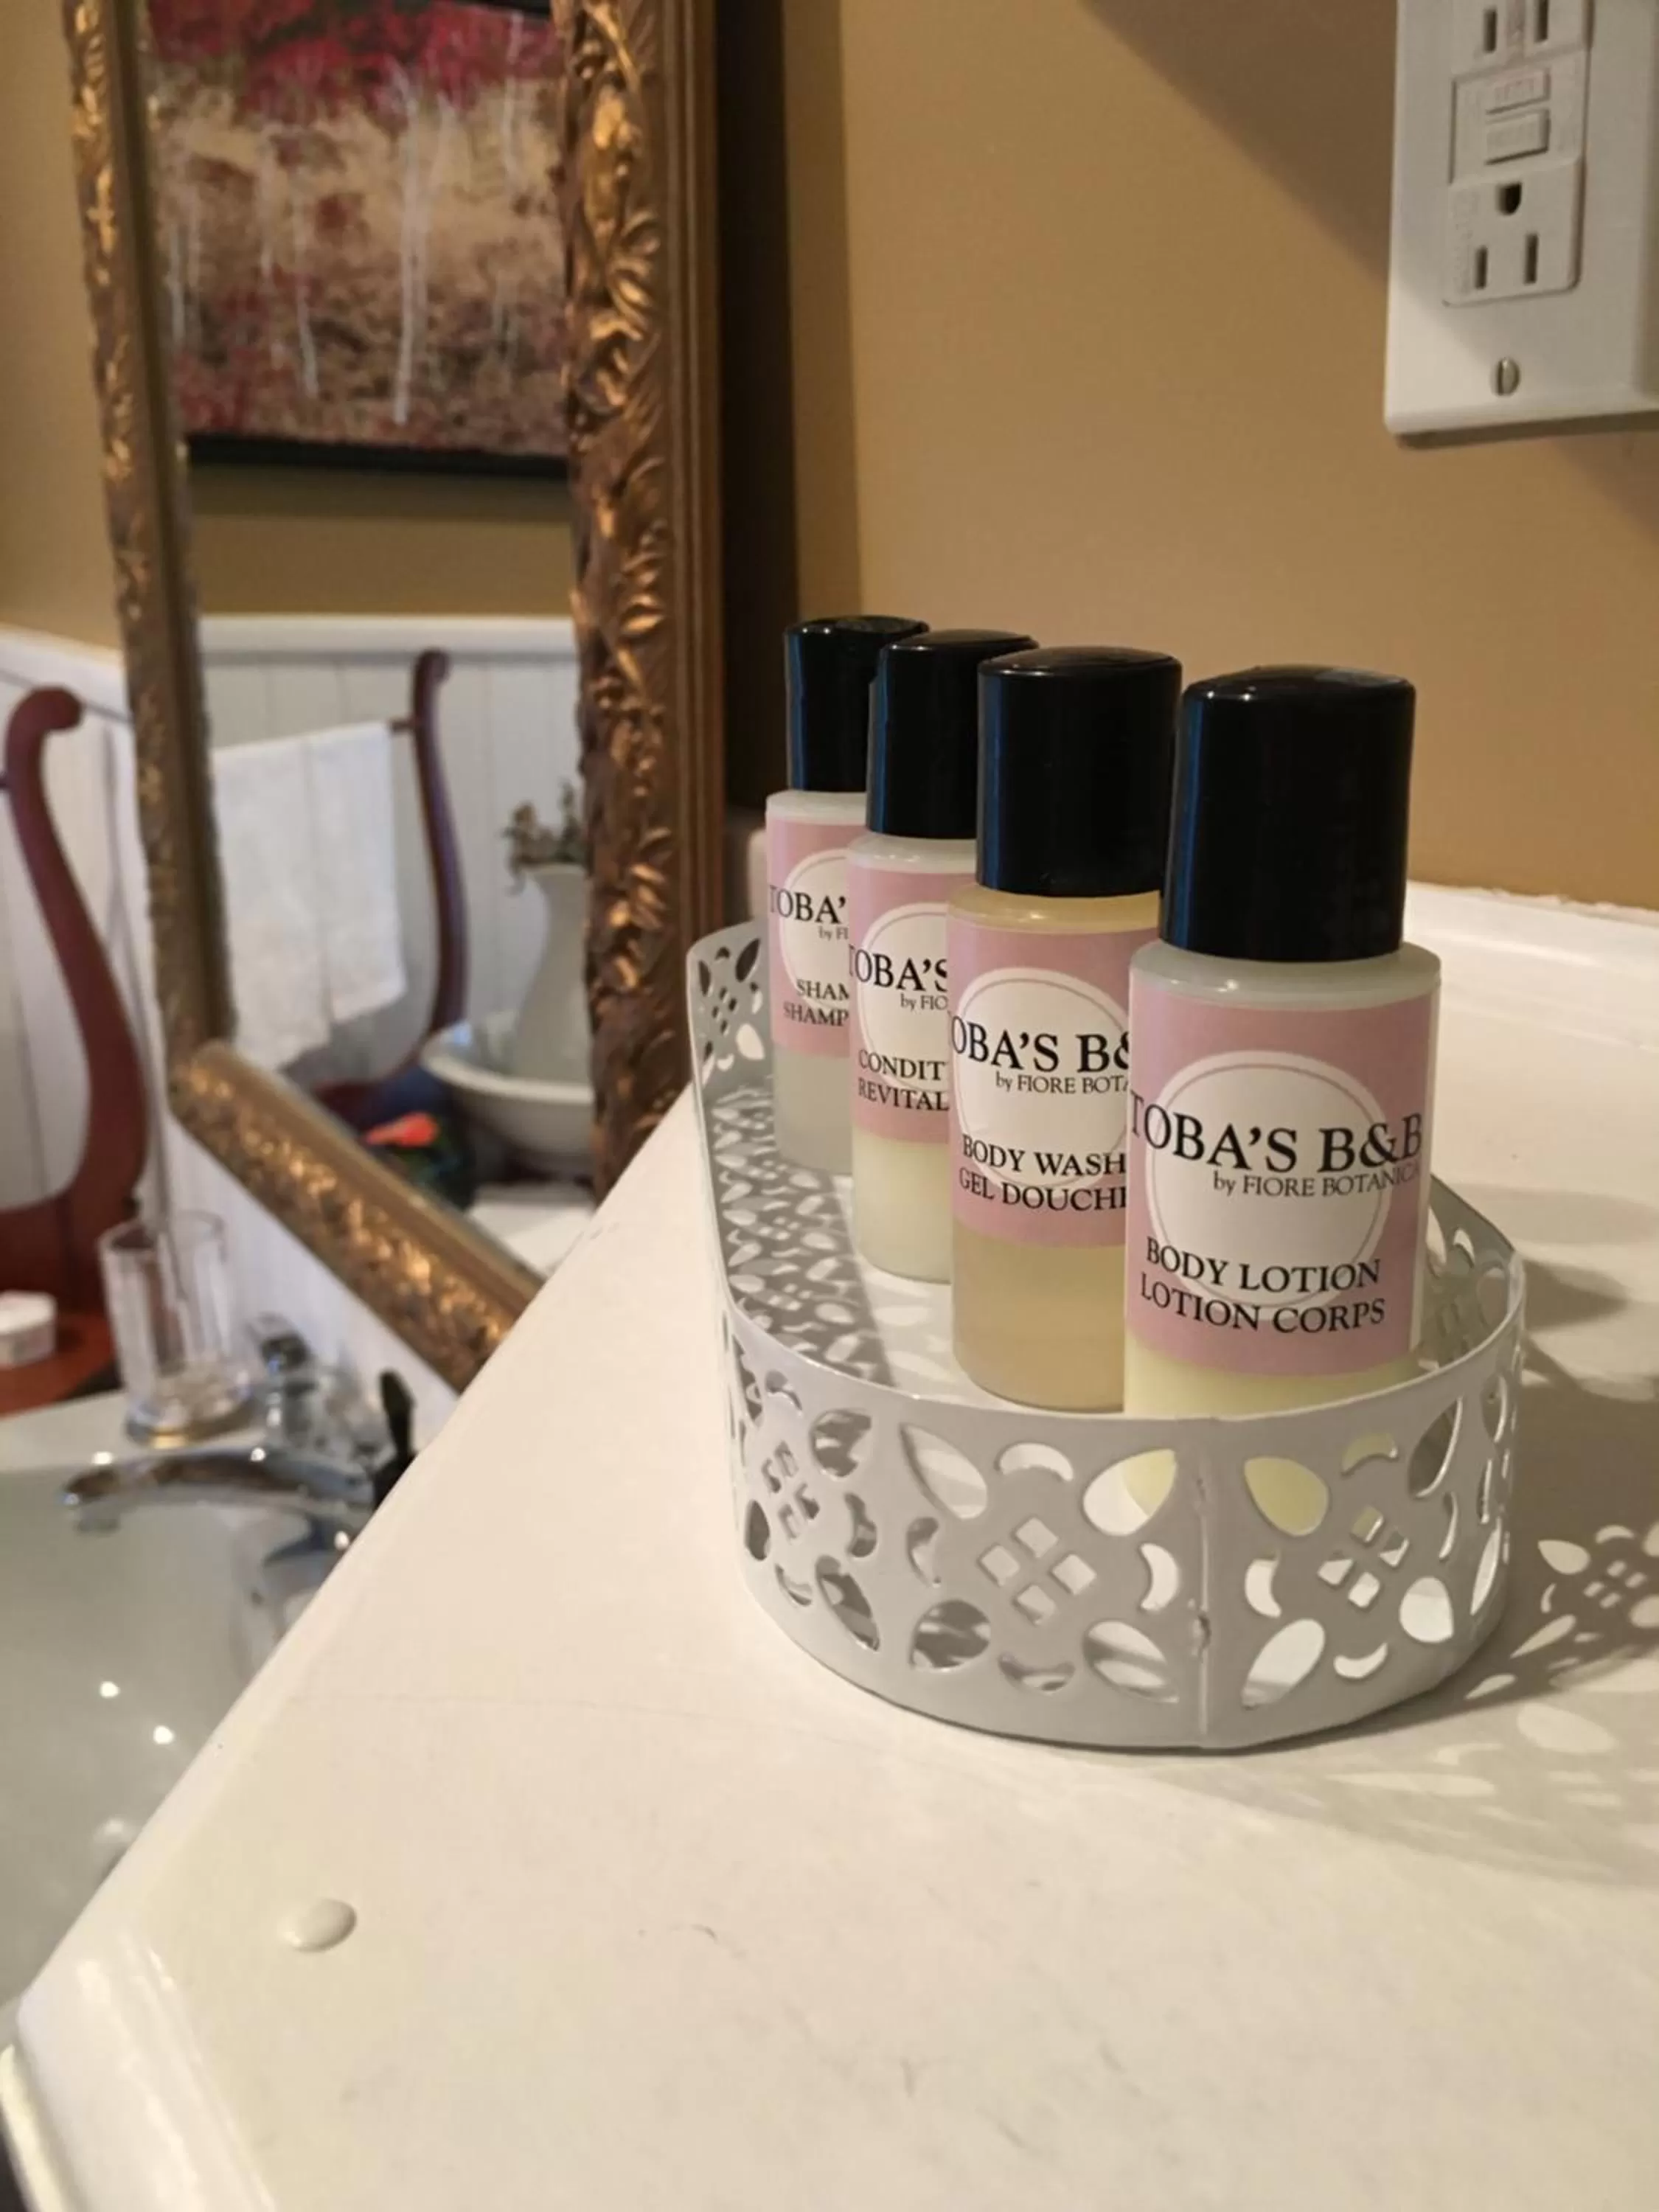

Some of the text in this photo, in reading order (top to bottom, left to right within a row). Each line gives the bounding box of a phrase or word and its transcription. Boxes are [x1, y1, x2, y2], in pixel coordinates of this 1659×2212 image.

[770, 885, 846, 924] TOBA'
[796, 978, 849, 1001] SHAM
[900, 993, 949, 1012] by FIO
[783, 1001, 849, 1026] SHAMP
[947, 1009, 1060, 1074] OBA'S
[858, 1048, 947, 1081] CONDIT
[858, 1077, 950, 1111] REVITAL
[995, 1071, 1013, 1093] by
[1018, 1074, 1077, 1094] FIORE
[1130, 1089, 1422, 1174] TOBA'S B&B
[961, 1133, 1126, 1178] BODY WASH
[959, 1166, 995, 1200] GEL
[1213, 1163, 1419, 1197] by FIORE BOTANIC
[1146, 1236, 1380, 1293] BODY LOTION
[1140, 1271, 1386, 1334] LOTION CORPS
